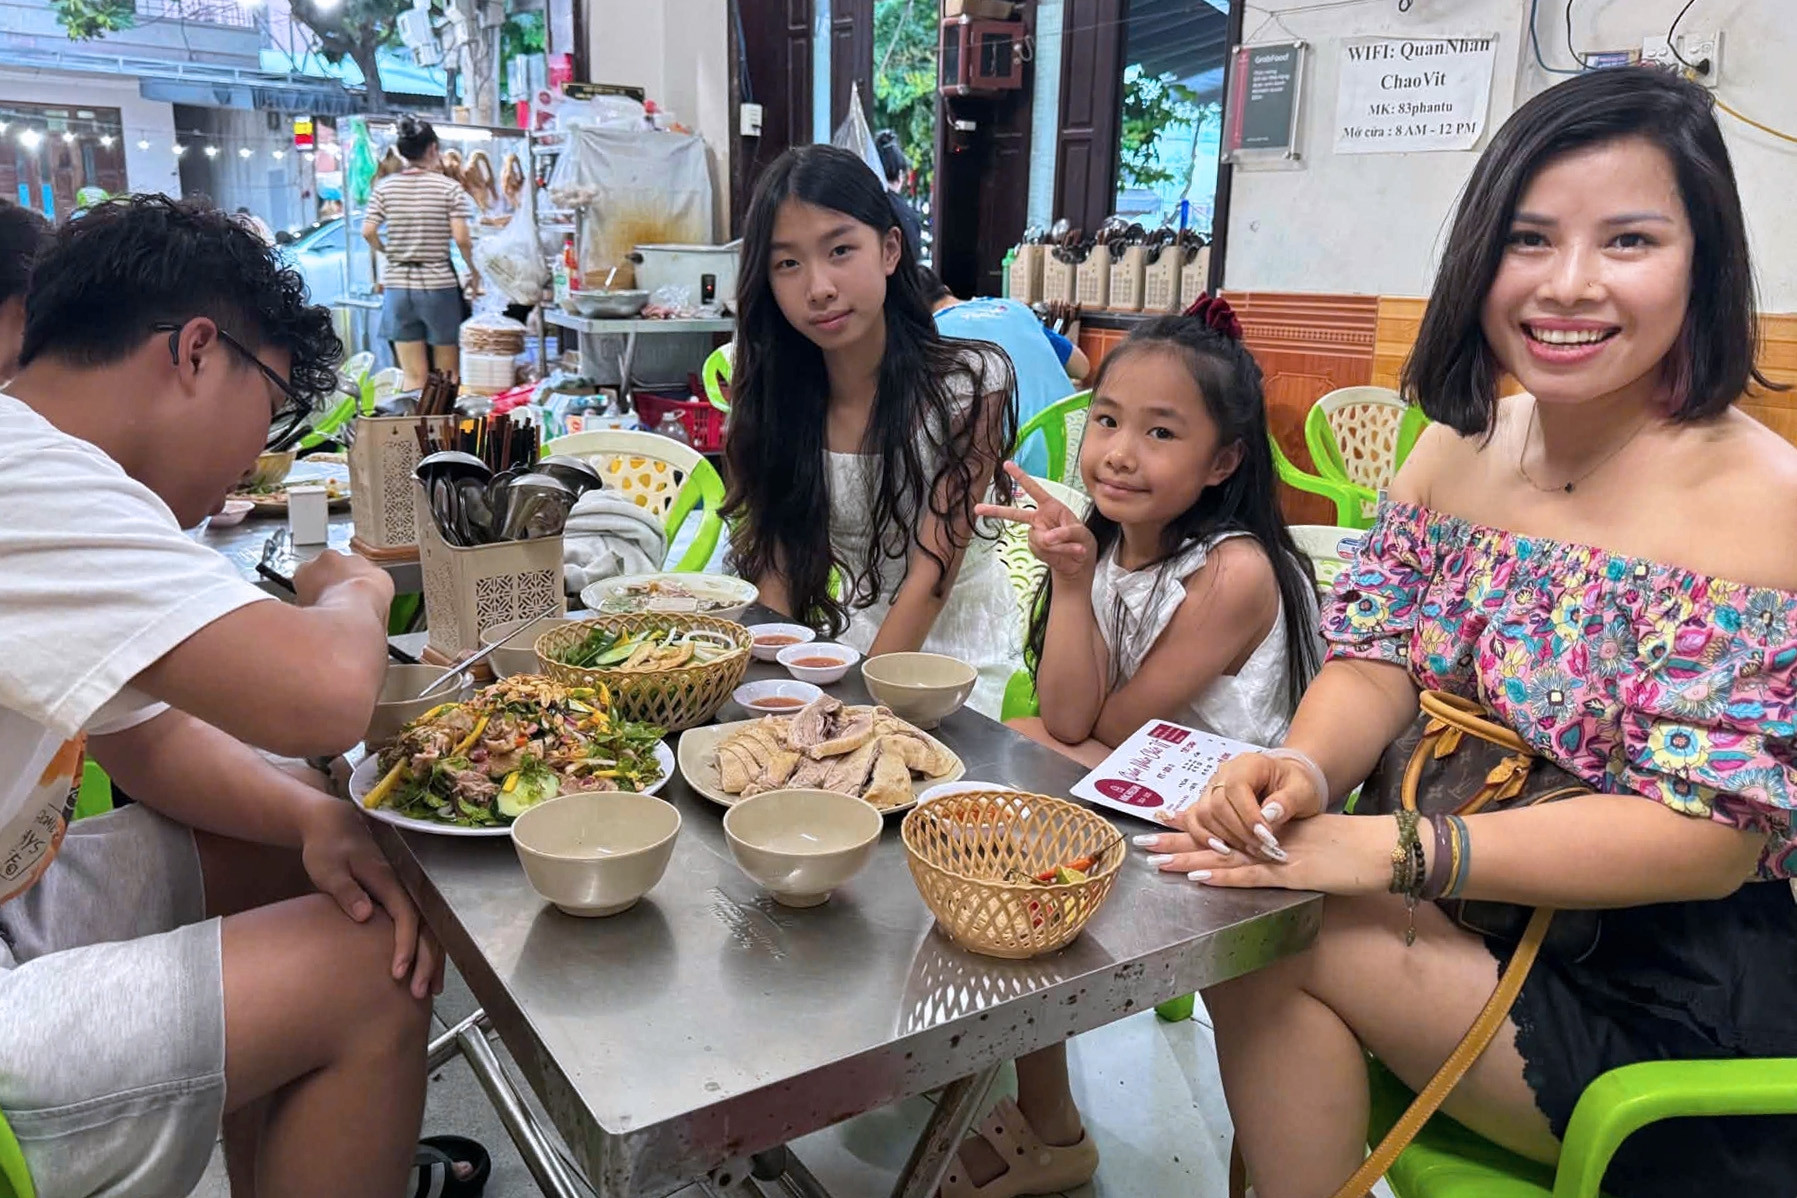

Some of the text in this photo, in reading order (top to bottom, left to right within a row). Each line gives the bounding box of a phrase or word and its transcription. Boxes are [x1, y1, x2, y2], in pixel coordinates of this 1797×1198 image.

[1348, 39, 1490, 61] WIFI: QuanNhan
[1381, 71, 1447, 90] ChaoVit
[1368, 102, 1453, 117] MK: 83phantu
[1395, 125, 1403, 136] 8
[1404, 124, 1427, 136] AM
[1439, 123, 1452, 135] 12
[1456, 122, 1476, 134] PM
